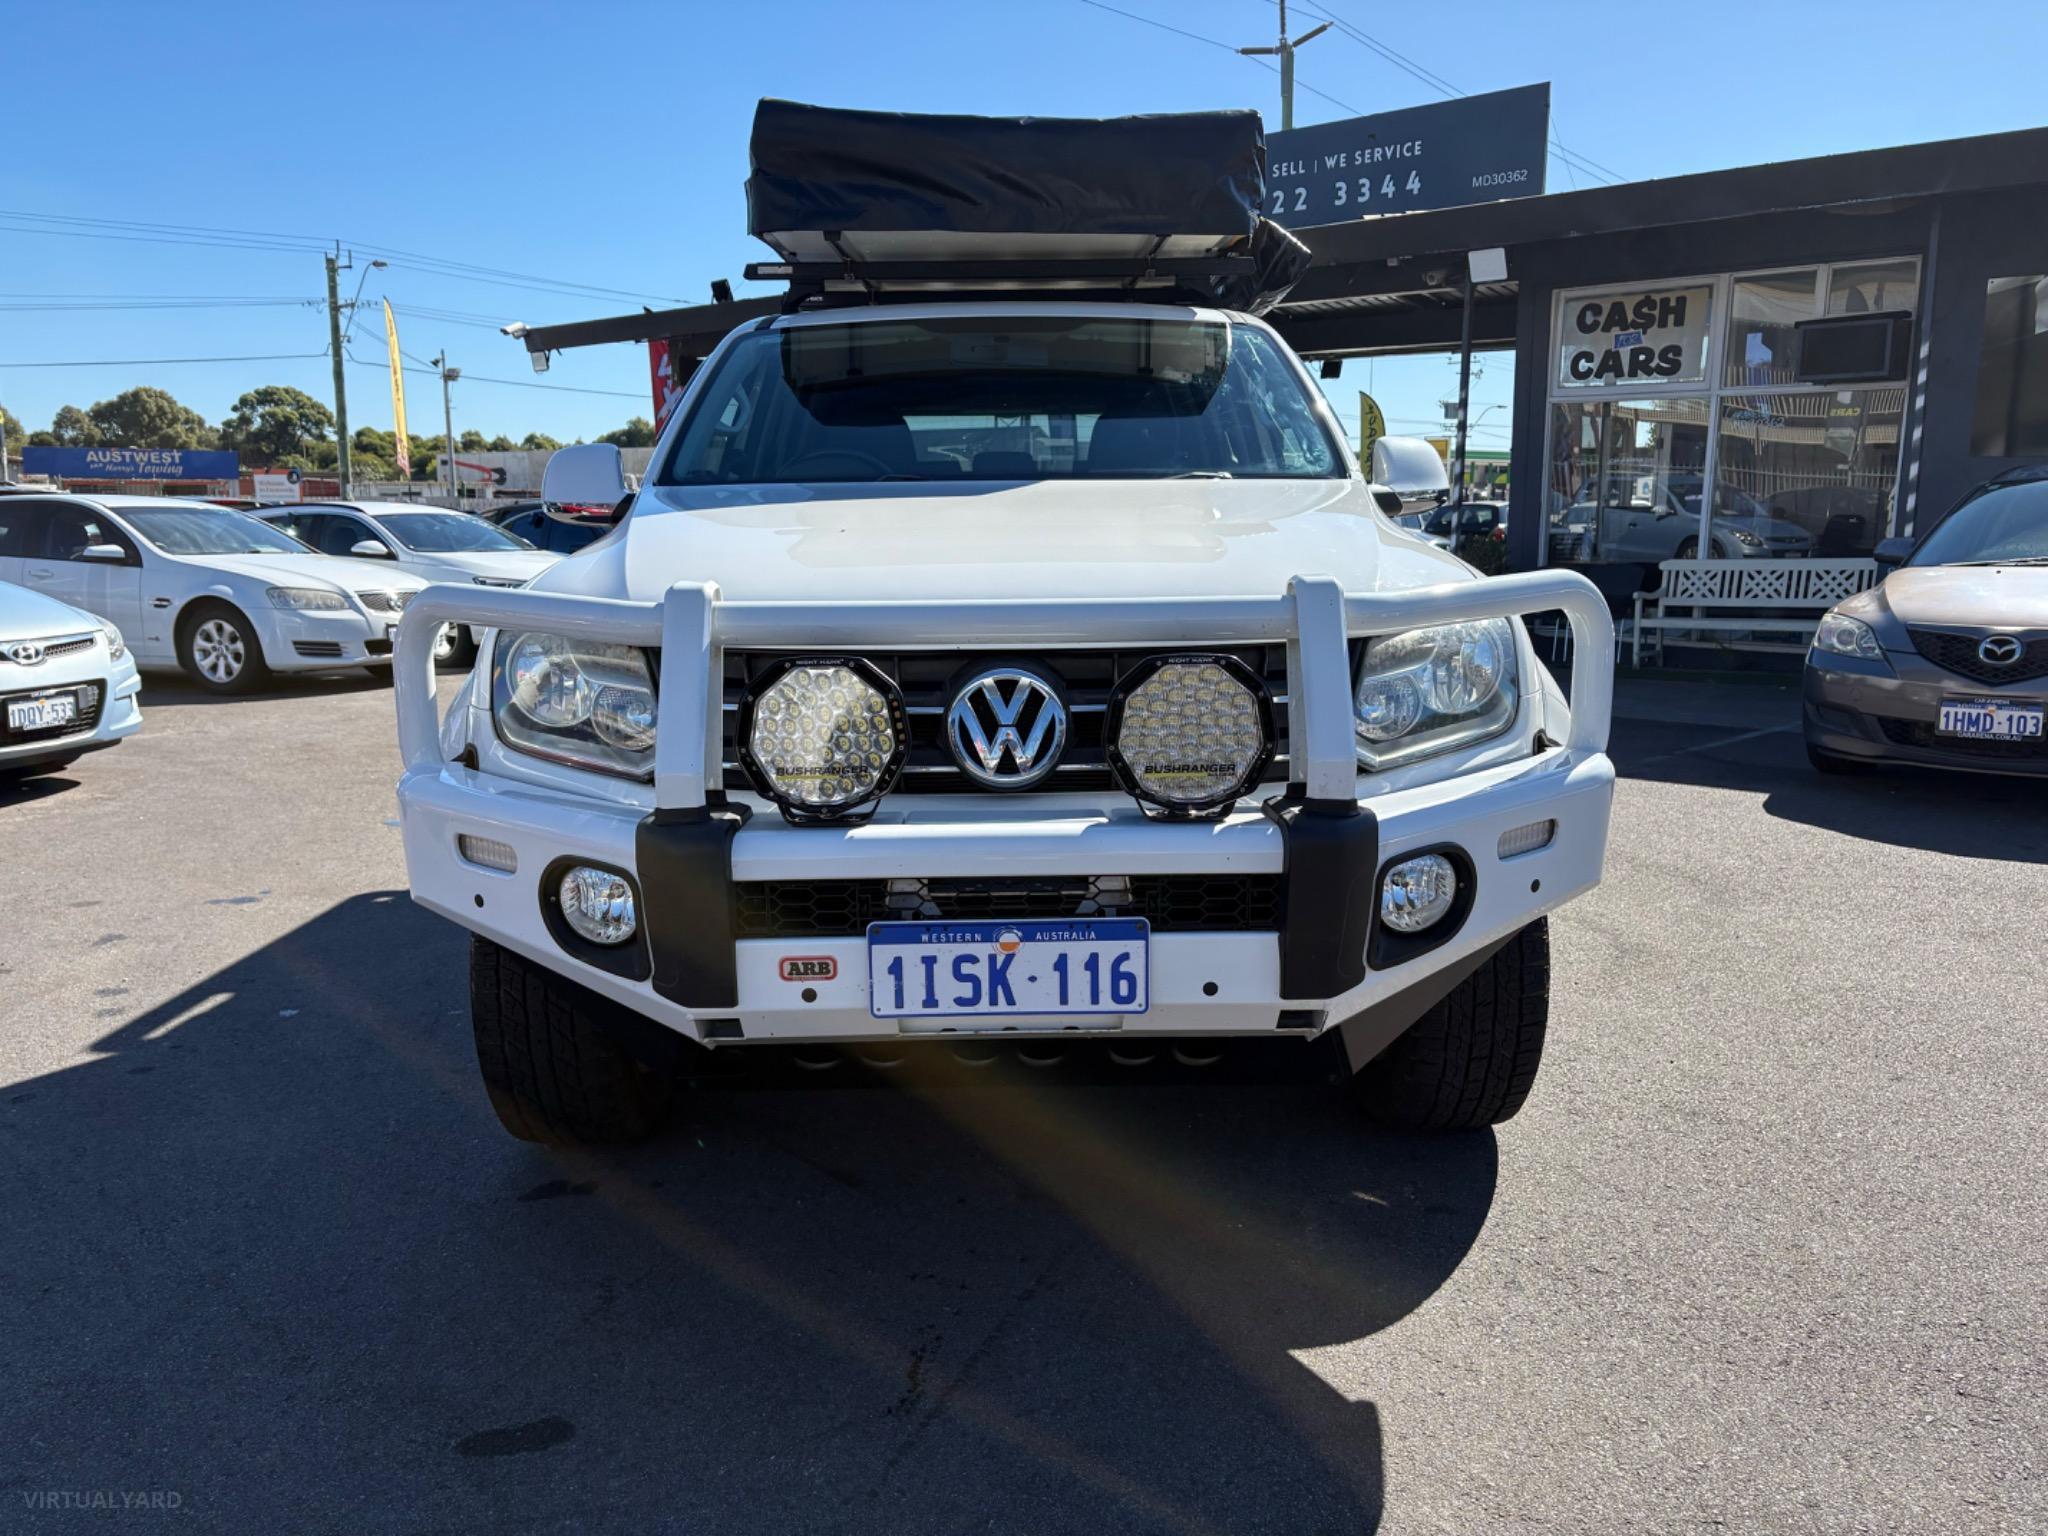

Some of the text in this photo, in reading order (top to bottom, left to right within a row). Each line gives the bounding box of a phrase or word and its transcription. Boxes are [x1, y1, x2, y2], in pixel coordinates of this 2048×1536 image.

[1272, 140, 1423, 178] SELL WE SERVICE
[1472, 168, 1529, 188] MD30362
[1333, 169, 1422, 206] 3344
[1570, 344, 1683, 381] CARS
[86, 449, 183, 464] AUSTWEST
[776, 766, 869, 776] BUSHRANGER
[1144, 763, 1236, 774] BUSHRANGER
[920, 931, 1097, 943] WESTERN AUSTRALIA
[787, 962, 832, 976] ARB
